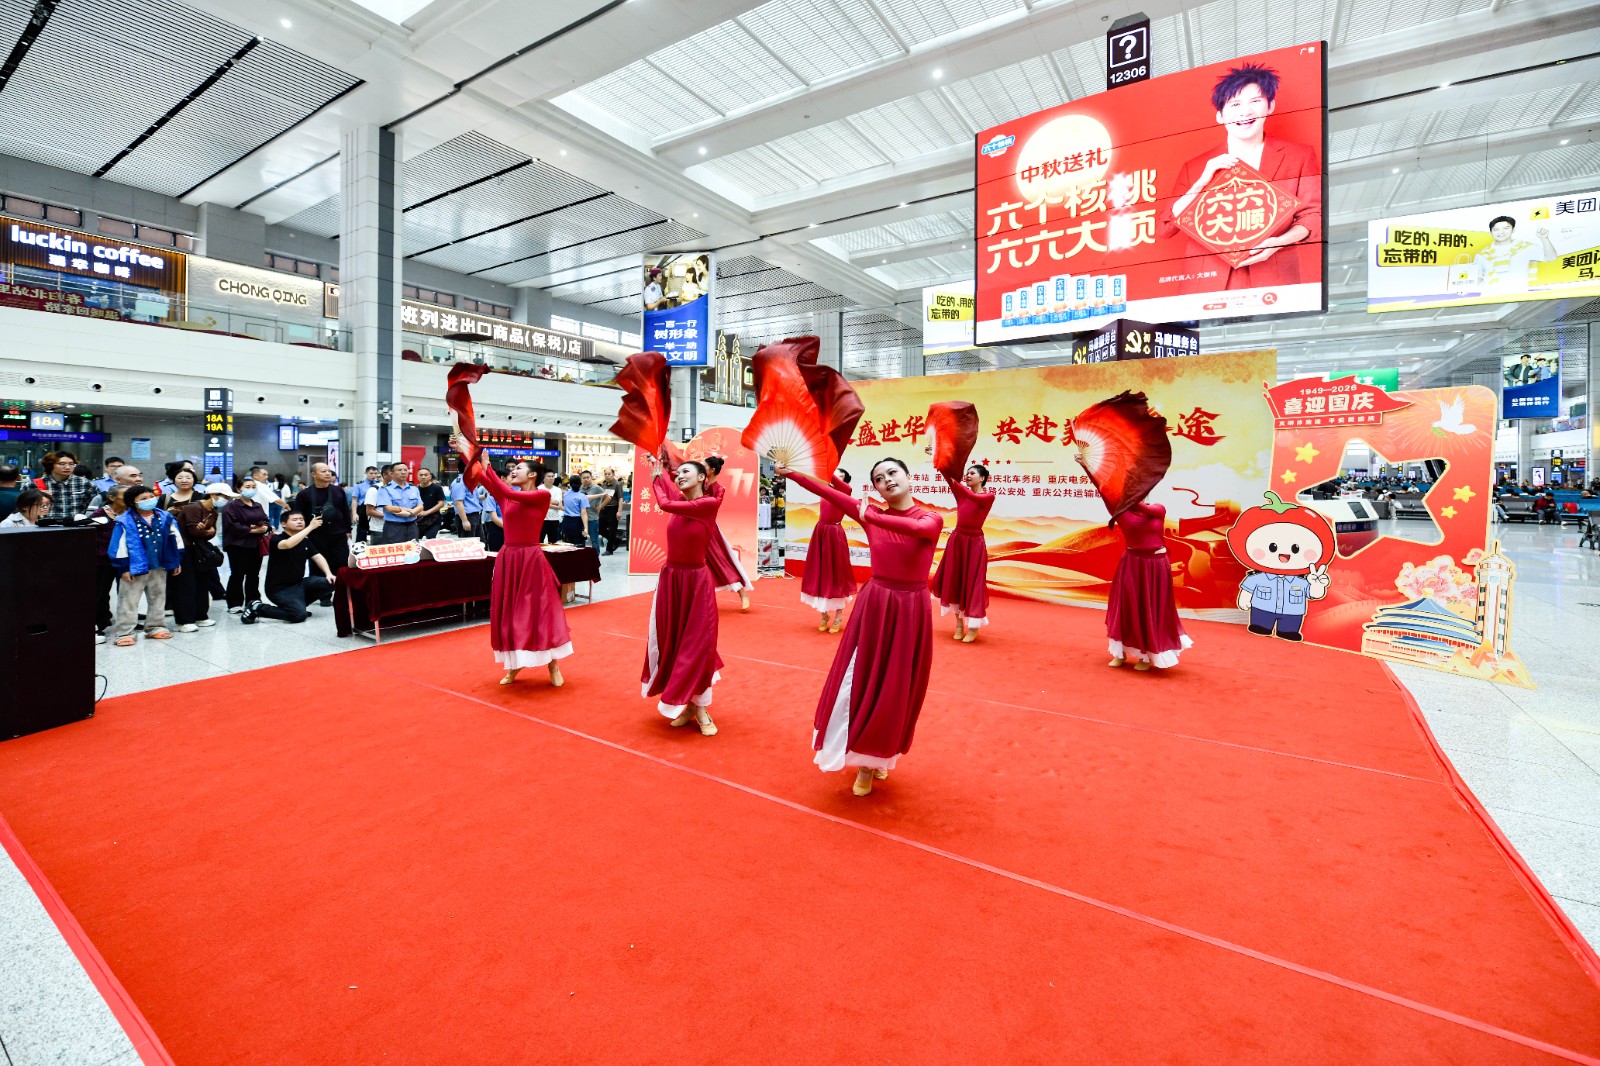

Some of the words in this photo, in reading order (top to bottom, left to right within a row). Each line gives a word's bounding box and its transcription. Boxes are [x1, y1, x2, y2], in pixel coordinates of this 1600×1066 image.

[1109, 65, 1147, 84] 12306
[1021, 147, 1108, 183] 中秋送礼
[986, 168, 1157, 237] 六个核桃
[1555, 197, 1600, 216] 美团
[11, 225, 87, 255] luckin
[93, 244, 164, 270] coffee
[986, 209, 1157, 274] 六六大顺
[1394, 229, 1474, 248] 吃的、用的、
[1383, 248, 1437, 264] 忘带的
[218, 279, 270, 299] CHONG
[272, 289, 307, 306] QING
[931, 308, 960, 320] 忘带的
[653, 319, 698, 329] 一言一行
[653, 328, 698, 340] 树形象
[653, 341, 698, 350] 一举一动
[1284, 391, 1375, 415] 喜迎国庆
[33, 416, 62, 427] 18A
[206, 414, 223, 422] 18A
[206, 423, 223, 432] 19A
[848, 415, 926, 447] 盛世华
[1047, 474, 1095, 485] 重庆电务
